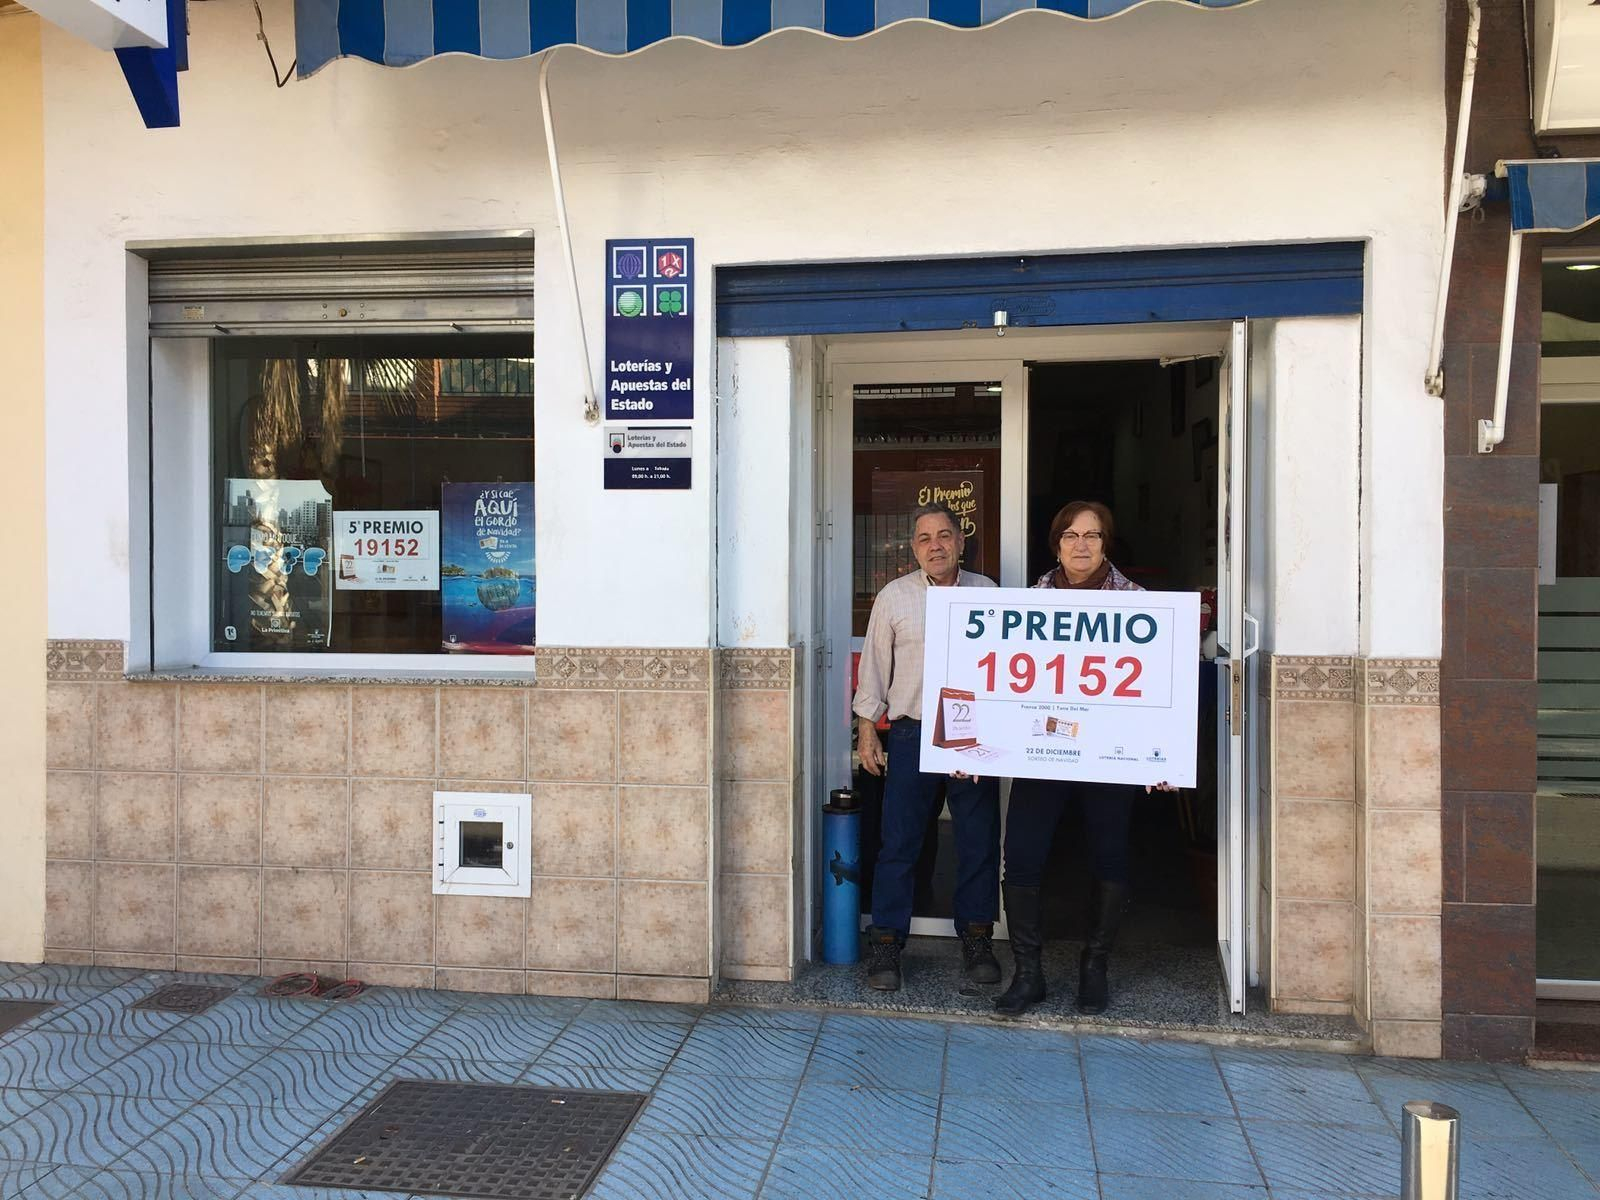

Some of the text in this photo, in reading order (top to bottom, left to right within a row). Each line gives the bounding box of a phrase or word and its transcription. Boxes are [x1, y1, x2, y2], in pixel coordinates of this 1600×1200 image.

[611, 359, 673, 375] Loterías y
[611, 378, 691, 394] Apuestas del
[611, 398, 654, 411] Estado
[918, 480, 974, 507] El Premio
[474, 498, 518, 517] AQUÍ
[956, 499, 977, 516] que
[363, 520, 423, 534] PREMIO
[354, 538, 419, 556] 19152
[1001, 609, 1158, 644] PREMIO
[977, 651, 1143, 698] 19152
[952, 703, 971, 722] 22
[1035, 747, 1044, 755] DE
[1045, 748, 1081, 756] DICIEMBRE
